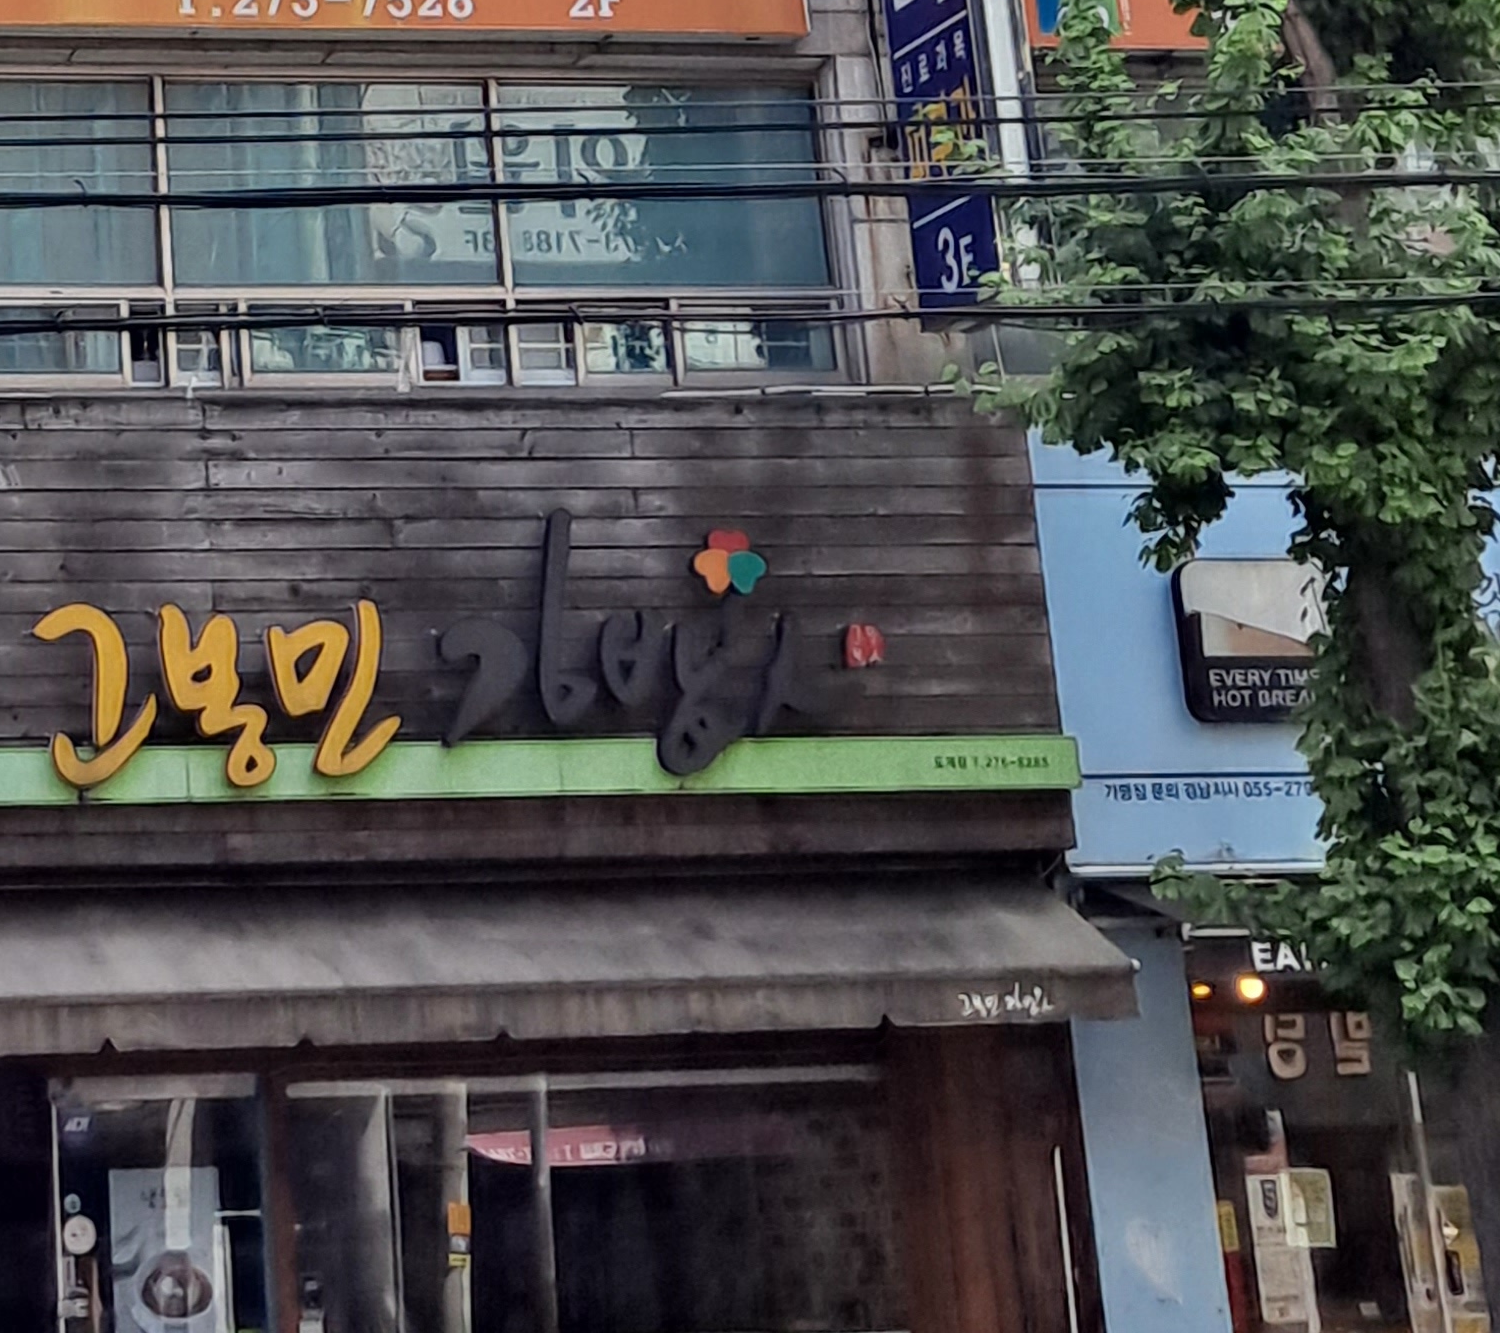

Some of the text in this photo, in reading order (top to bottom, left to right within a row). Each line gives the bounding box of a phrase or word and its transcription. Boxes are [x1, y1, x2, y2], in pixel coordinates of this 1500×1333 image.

[937, 226, 974, 294] 3F
[1208, 668, 1272, 688] EVERY
[1212, 688, 1316, 708] HOT BREA
